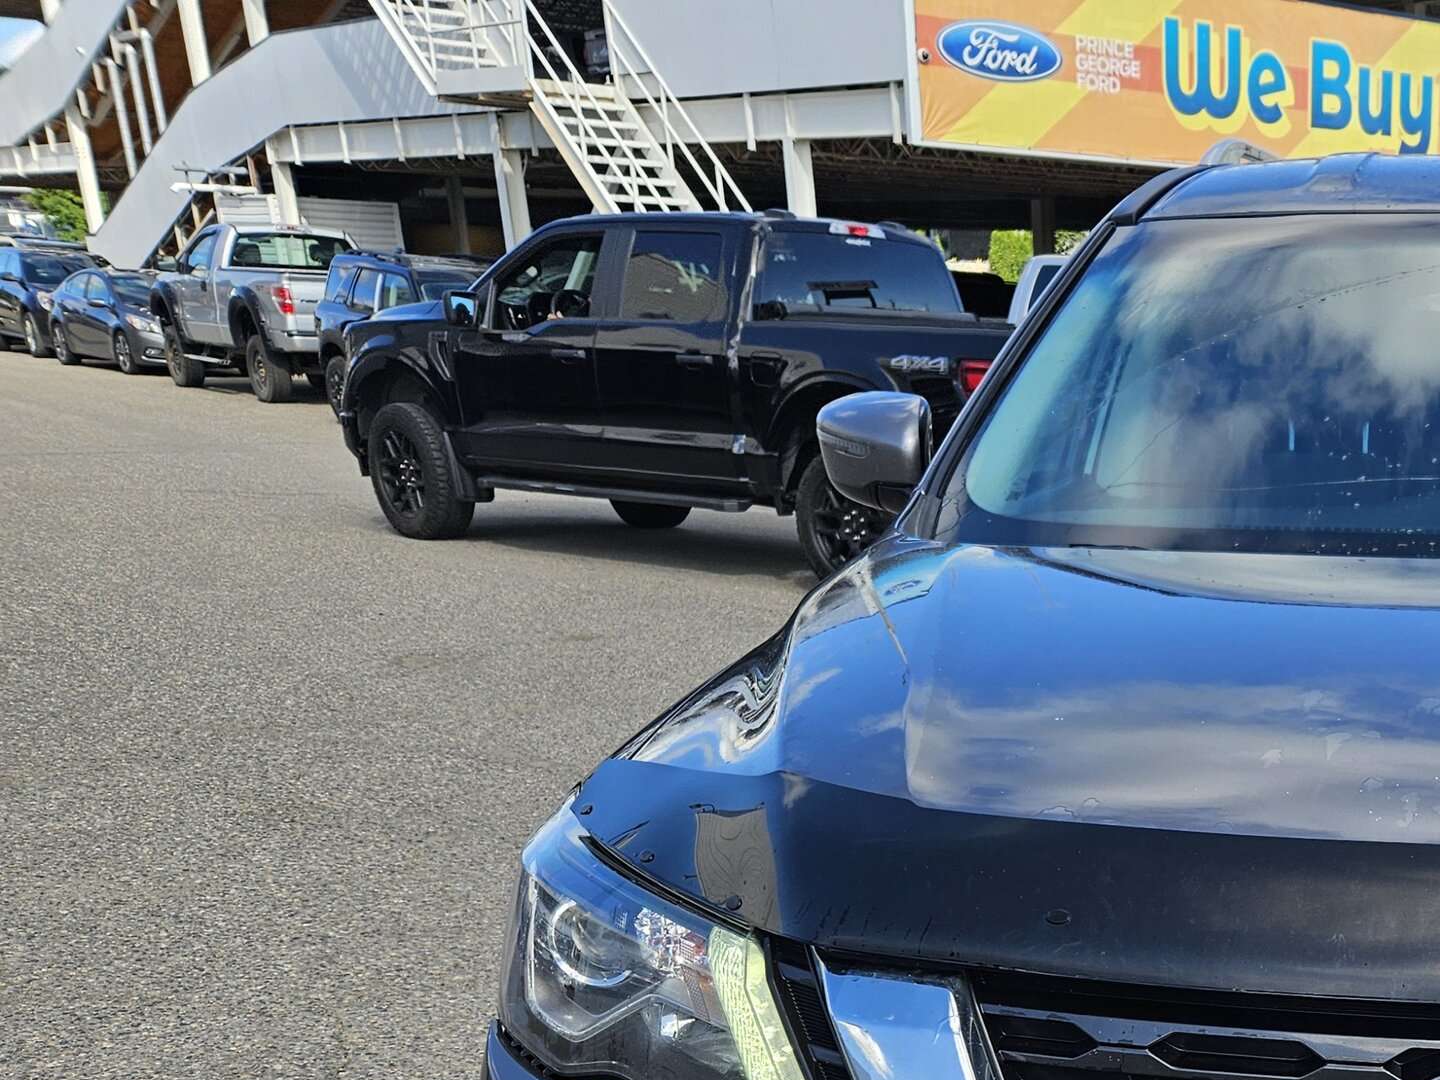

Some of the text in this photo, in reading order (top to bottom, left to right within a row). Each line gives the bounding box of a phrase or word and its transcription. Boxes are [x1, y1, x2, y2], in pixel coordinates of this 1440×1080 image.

[962, 27, 1039, 75] Ford
[1075, 35, 1135, 58] PRINCE
[1075, 54, 1141, 80] GEORGE
[1076, 72, 1121, 93] FORD
[1163, 16, 1287, 125] We
[1310, 39, 1434, 155] Buy
